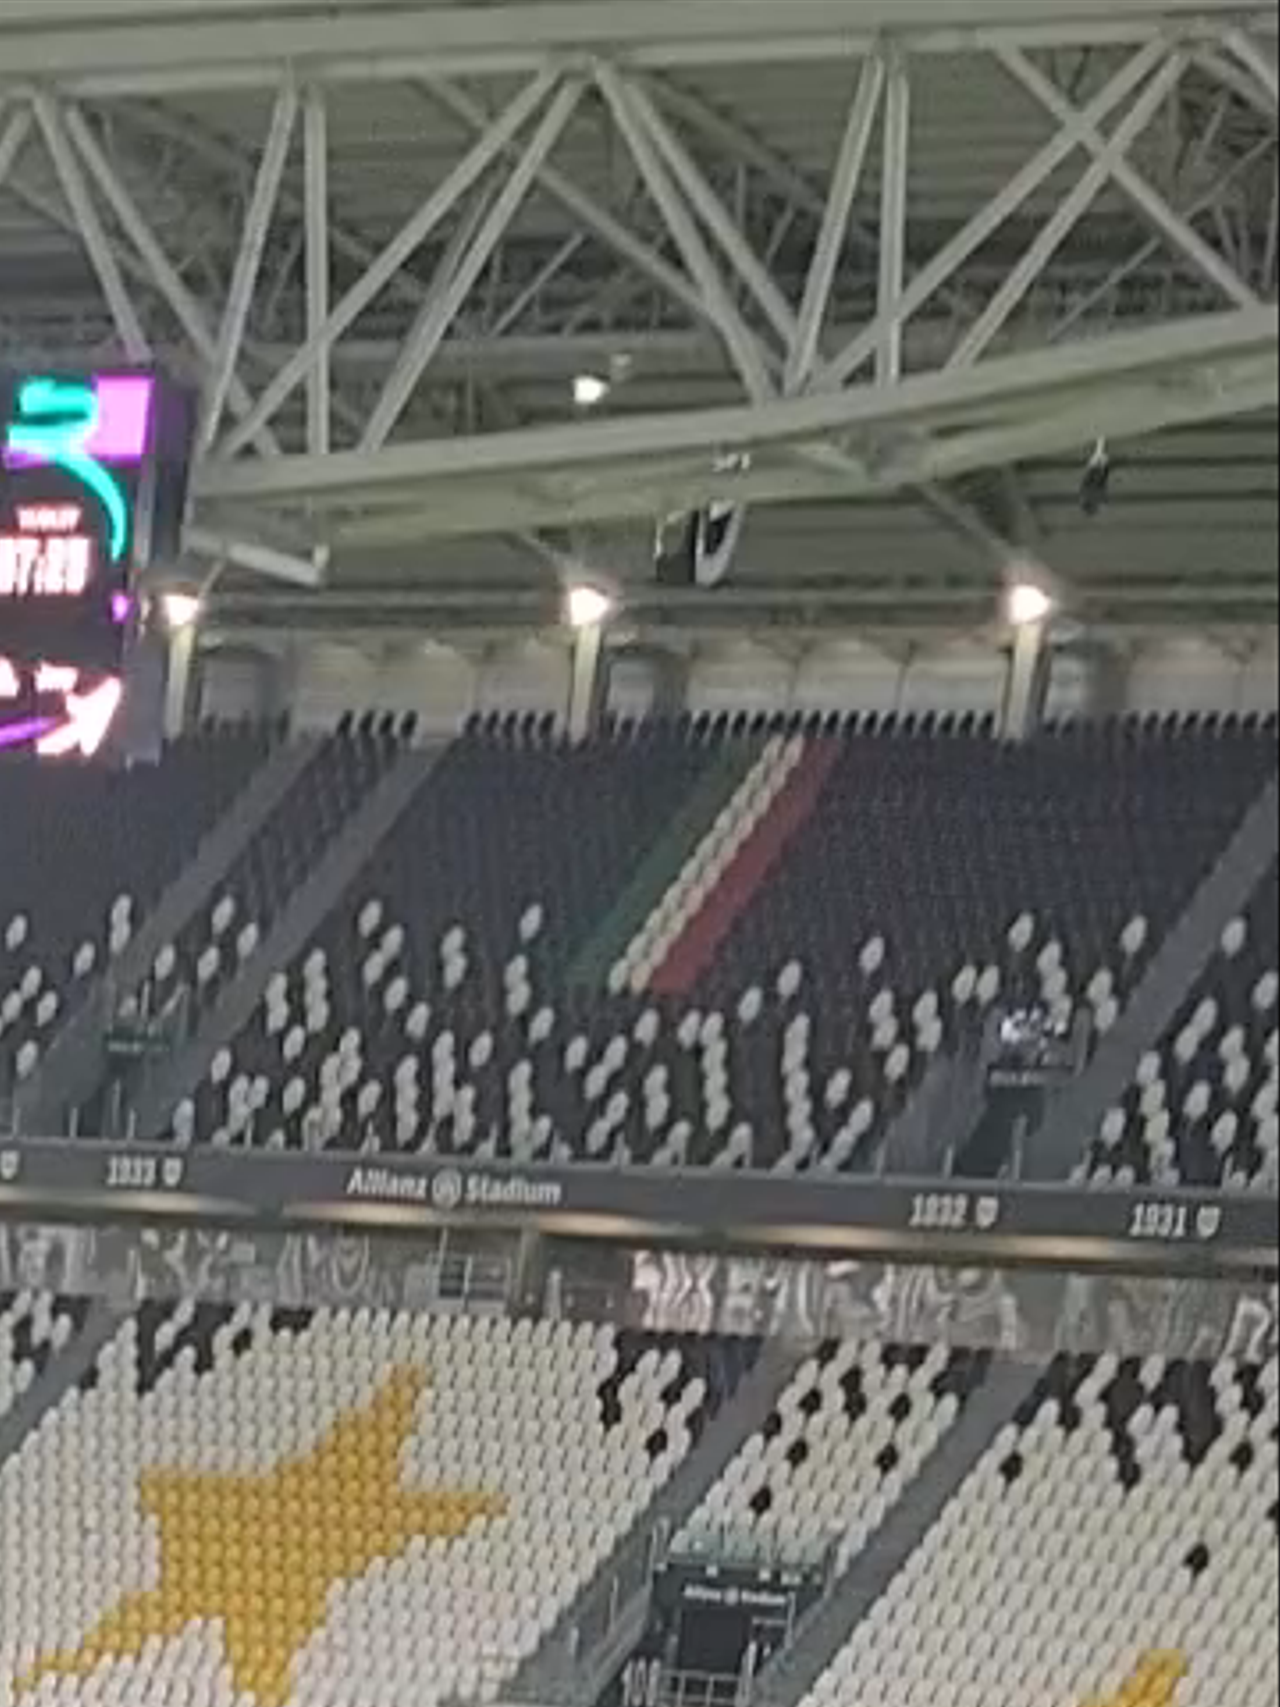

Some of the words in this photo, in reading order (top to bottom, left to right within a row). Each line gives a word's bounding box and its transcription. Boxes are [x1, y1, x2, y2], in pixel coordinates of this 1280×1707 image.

[345, 1166, 427, 1199] Allianz
[467, 1172, 562, 1207] Stadium
[1130, 1203, 1187, 1238] 1931
